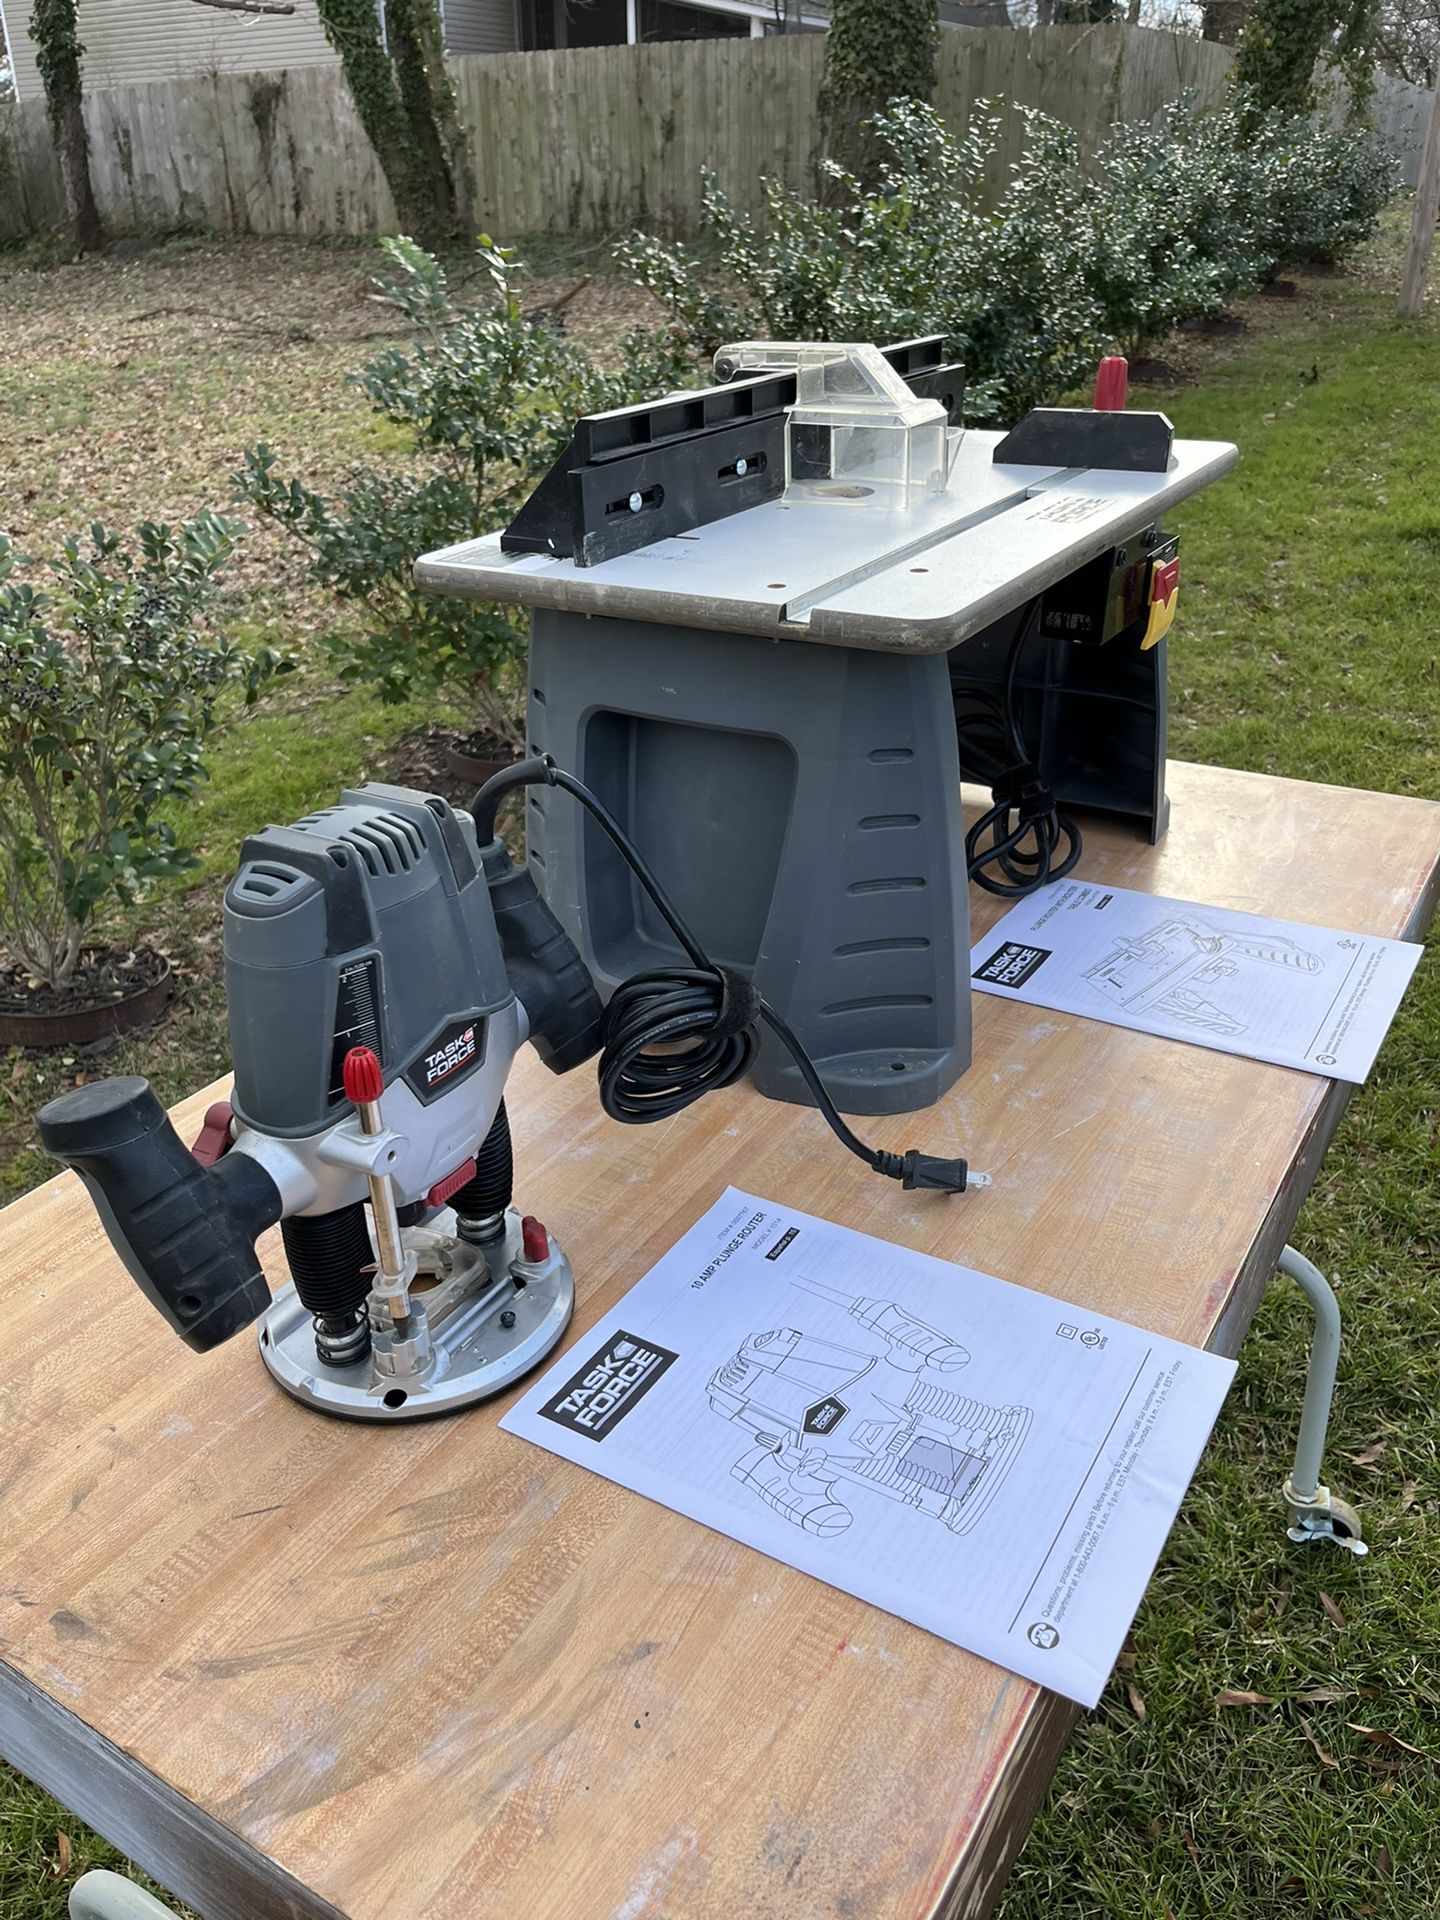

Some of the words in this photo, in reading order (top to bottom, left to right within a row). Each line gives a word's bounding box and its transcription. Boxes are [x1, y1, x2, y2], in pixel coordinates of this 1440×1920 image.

[981, 952, 1017, 977] TASK
[997, 948, 1037, 983] FORCE
[425, 1034, 465, 1068] TASK
[426, 1042, 476, 1083] FORCE
[691, 1280, 704, 1290] 10
[699, 1265, 717, 1283] AMP
[712, 1238, 743, 1267] PLUNGE
[737, 1211, 767, 1240] ROUTER
[751, 1232, 769, 1250] MODEL
[769, 1240, 787, 1257] Español
[554, 1354, 626, 1414] TASK
[574, 1348, 657, 1428] FORCE
[810, 1408, 826, 1426] TASK
[816, 1406, 838, 1429] FORCE
[1042, 1583, 1063, 1617] Questions,
[1059, 1553, 1078, 1583] problems,
[1074, 1530, 1090, 1553] missing
[1085, 1511, 1098, 1529] parts?
[1093, 1492, 1106, 1510] Before
[1103, 1468, 1119, 1492] returning
[1119, 1450, 1128, 1460] your
[1124, 1430, 1137, 1448] retailer,
[1138, 1411, 1146, 1420] our
[1142, 1389, 1156, 1410] customer
[1153, 1372, 1164, 1387] service
[1053, 1586, 1075, 1622] department
[1124, 1452, 1138, 1473] Monday
